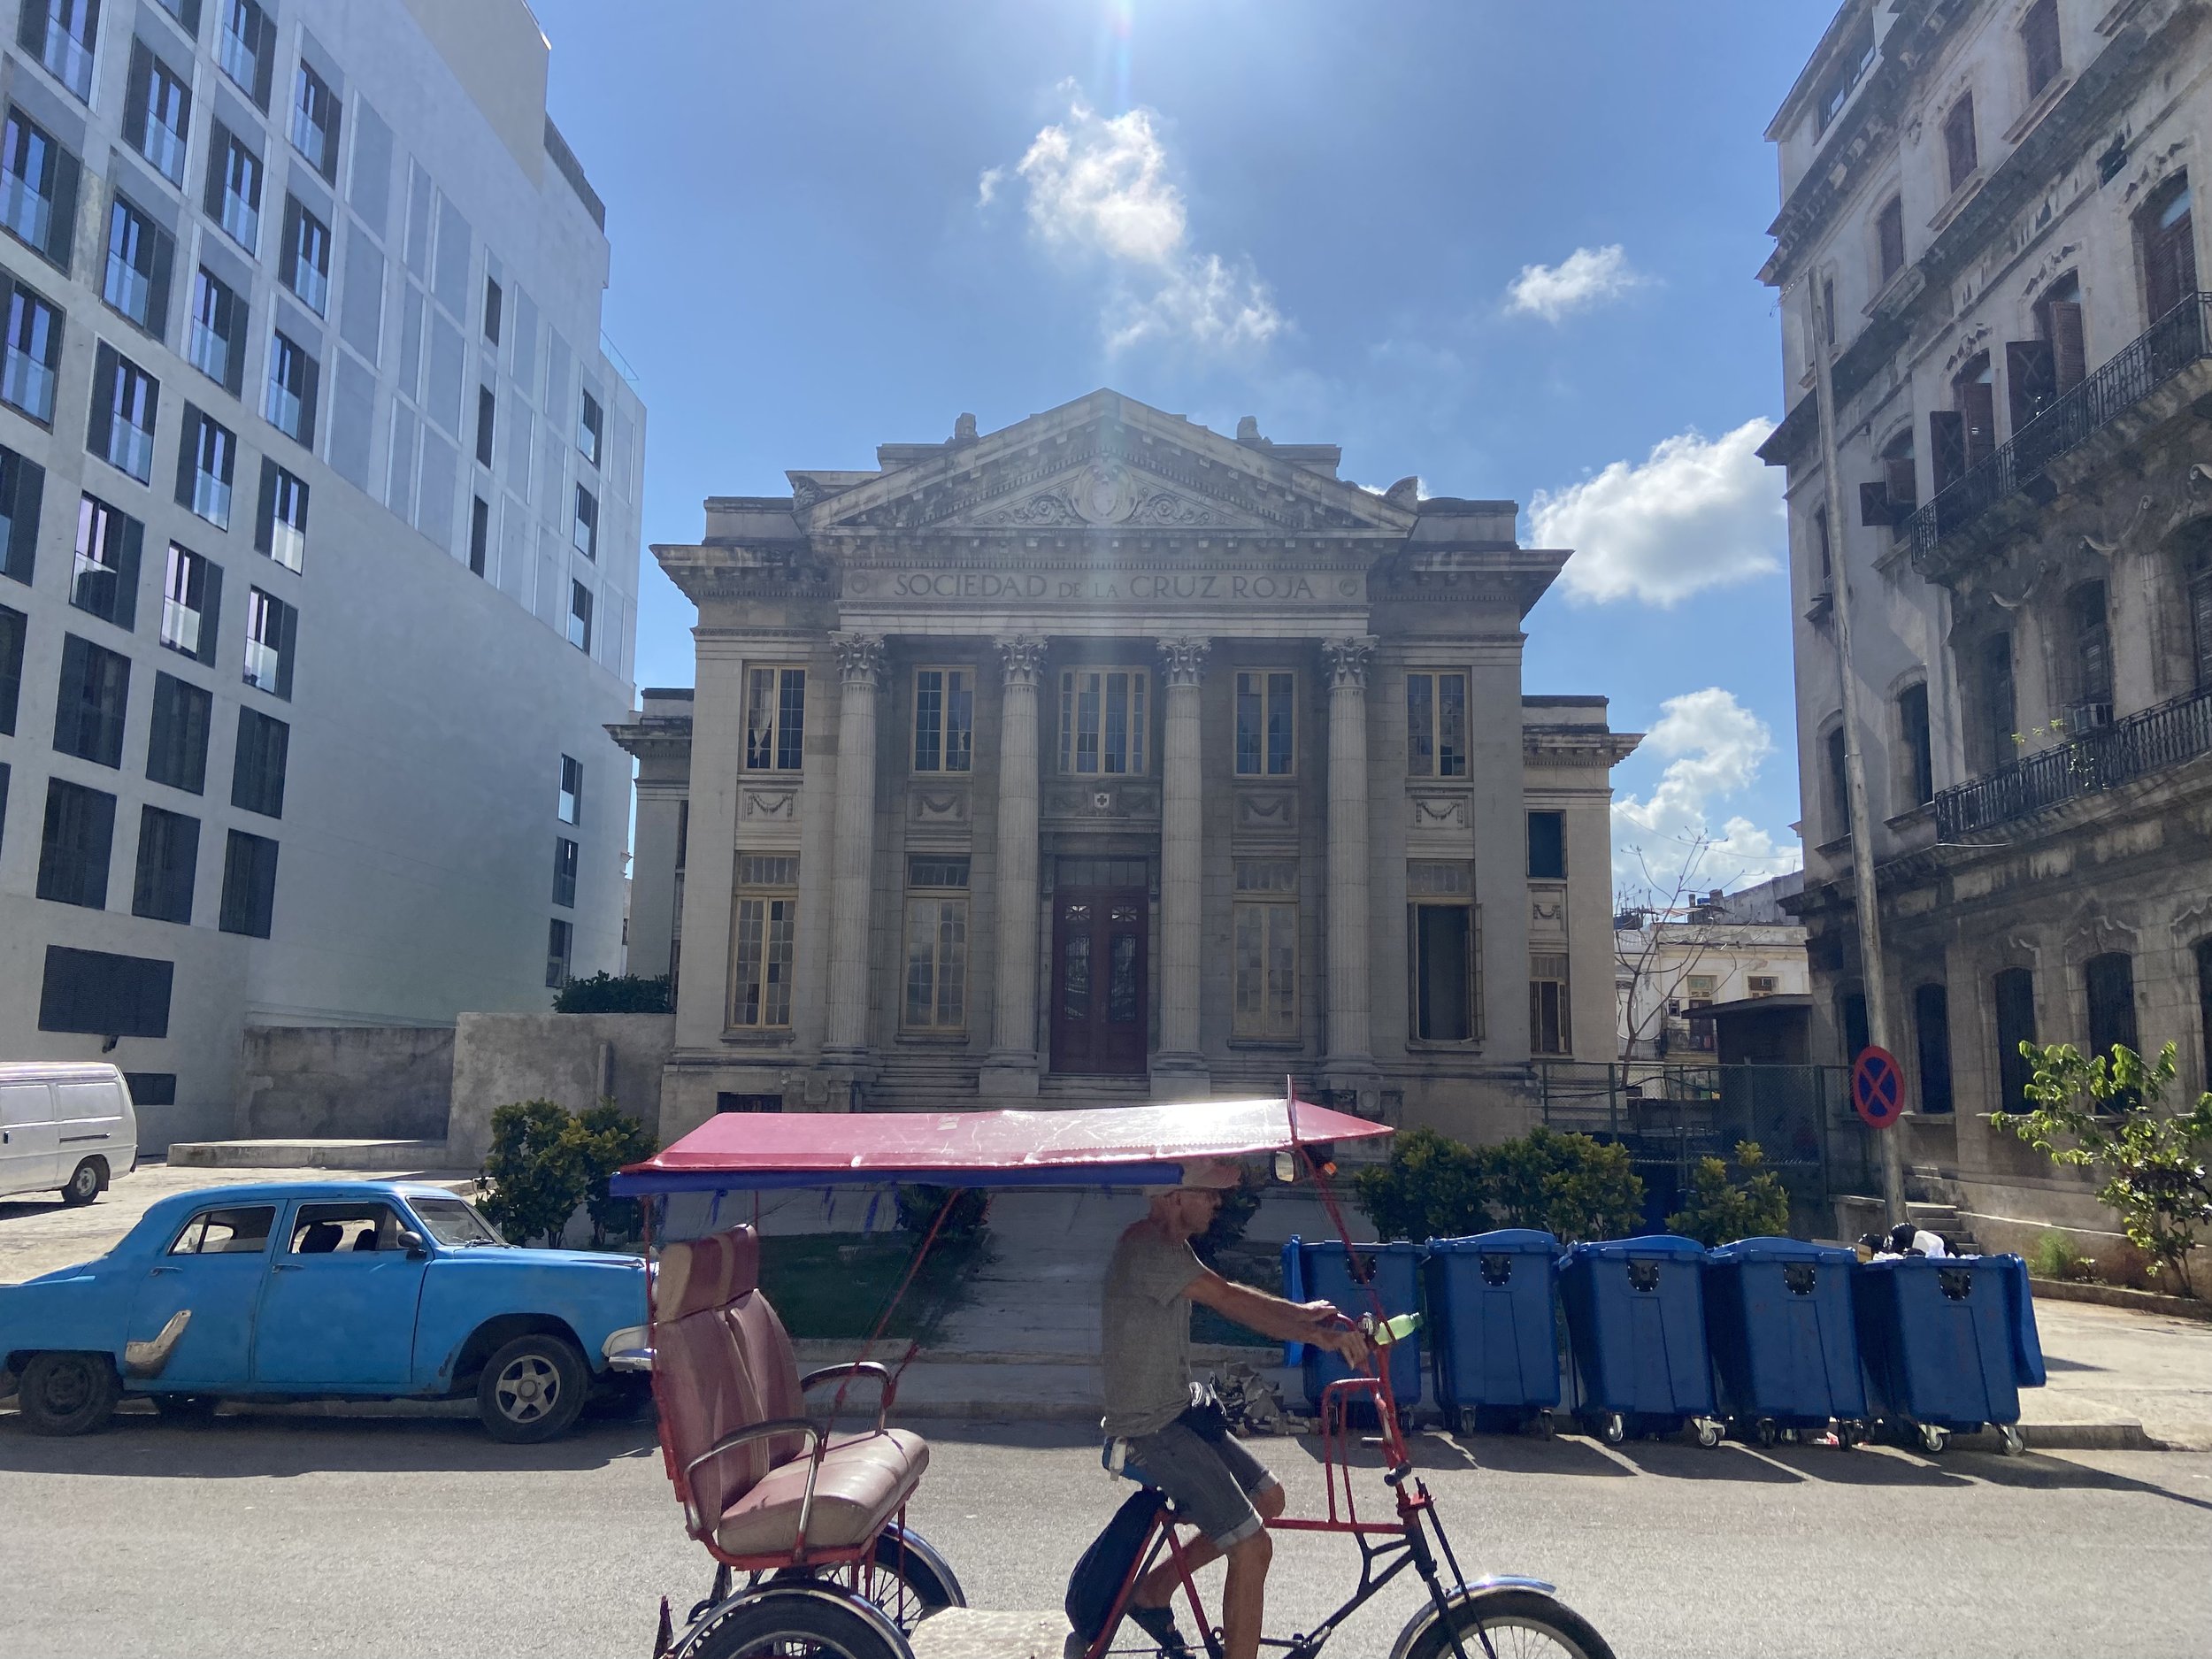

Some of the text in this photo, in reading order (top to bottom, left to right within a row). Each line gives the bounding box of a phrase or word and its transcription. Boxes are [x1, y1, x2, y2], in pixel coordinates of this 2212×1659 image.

[894, 574, 1317, 599] SOCIEDAD DE LA CRUZ ROJA
